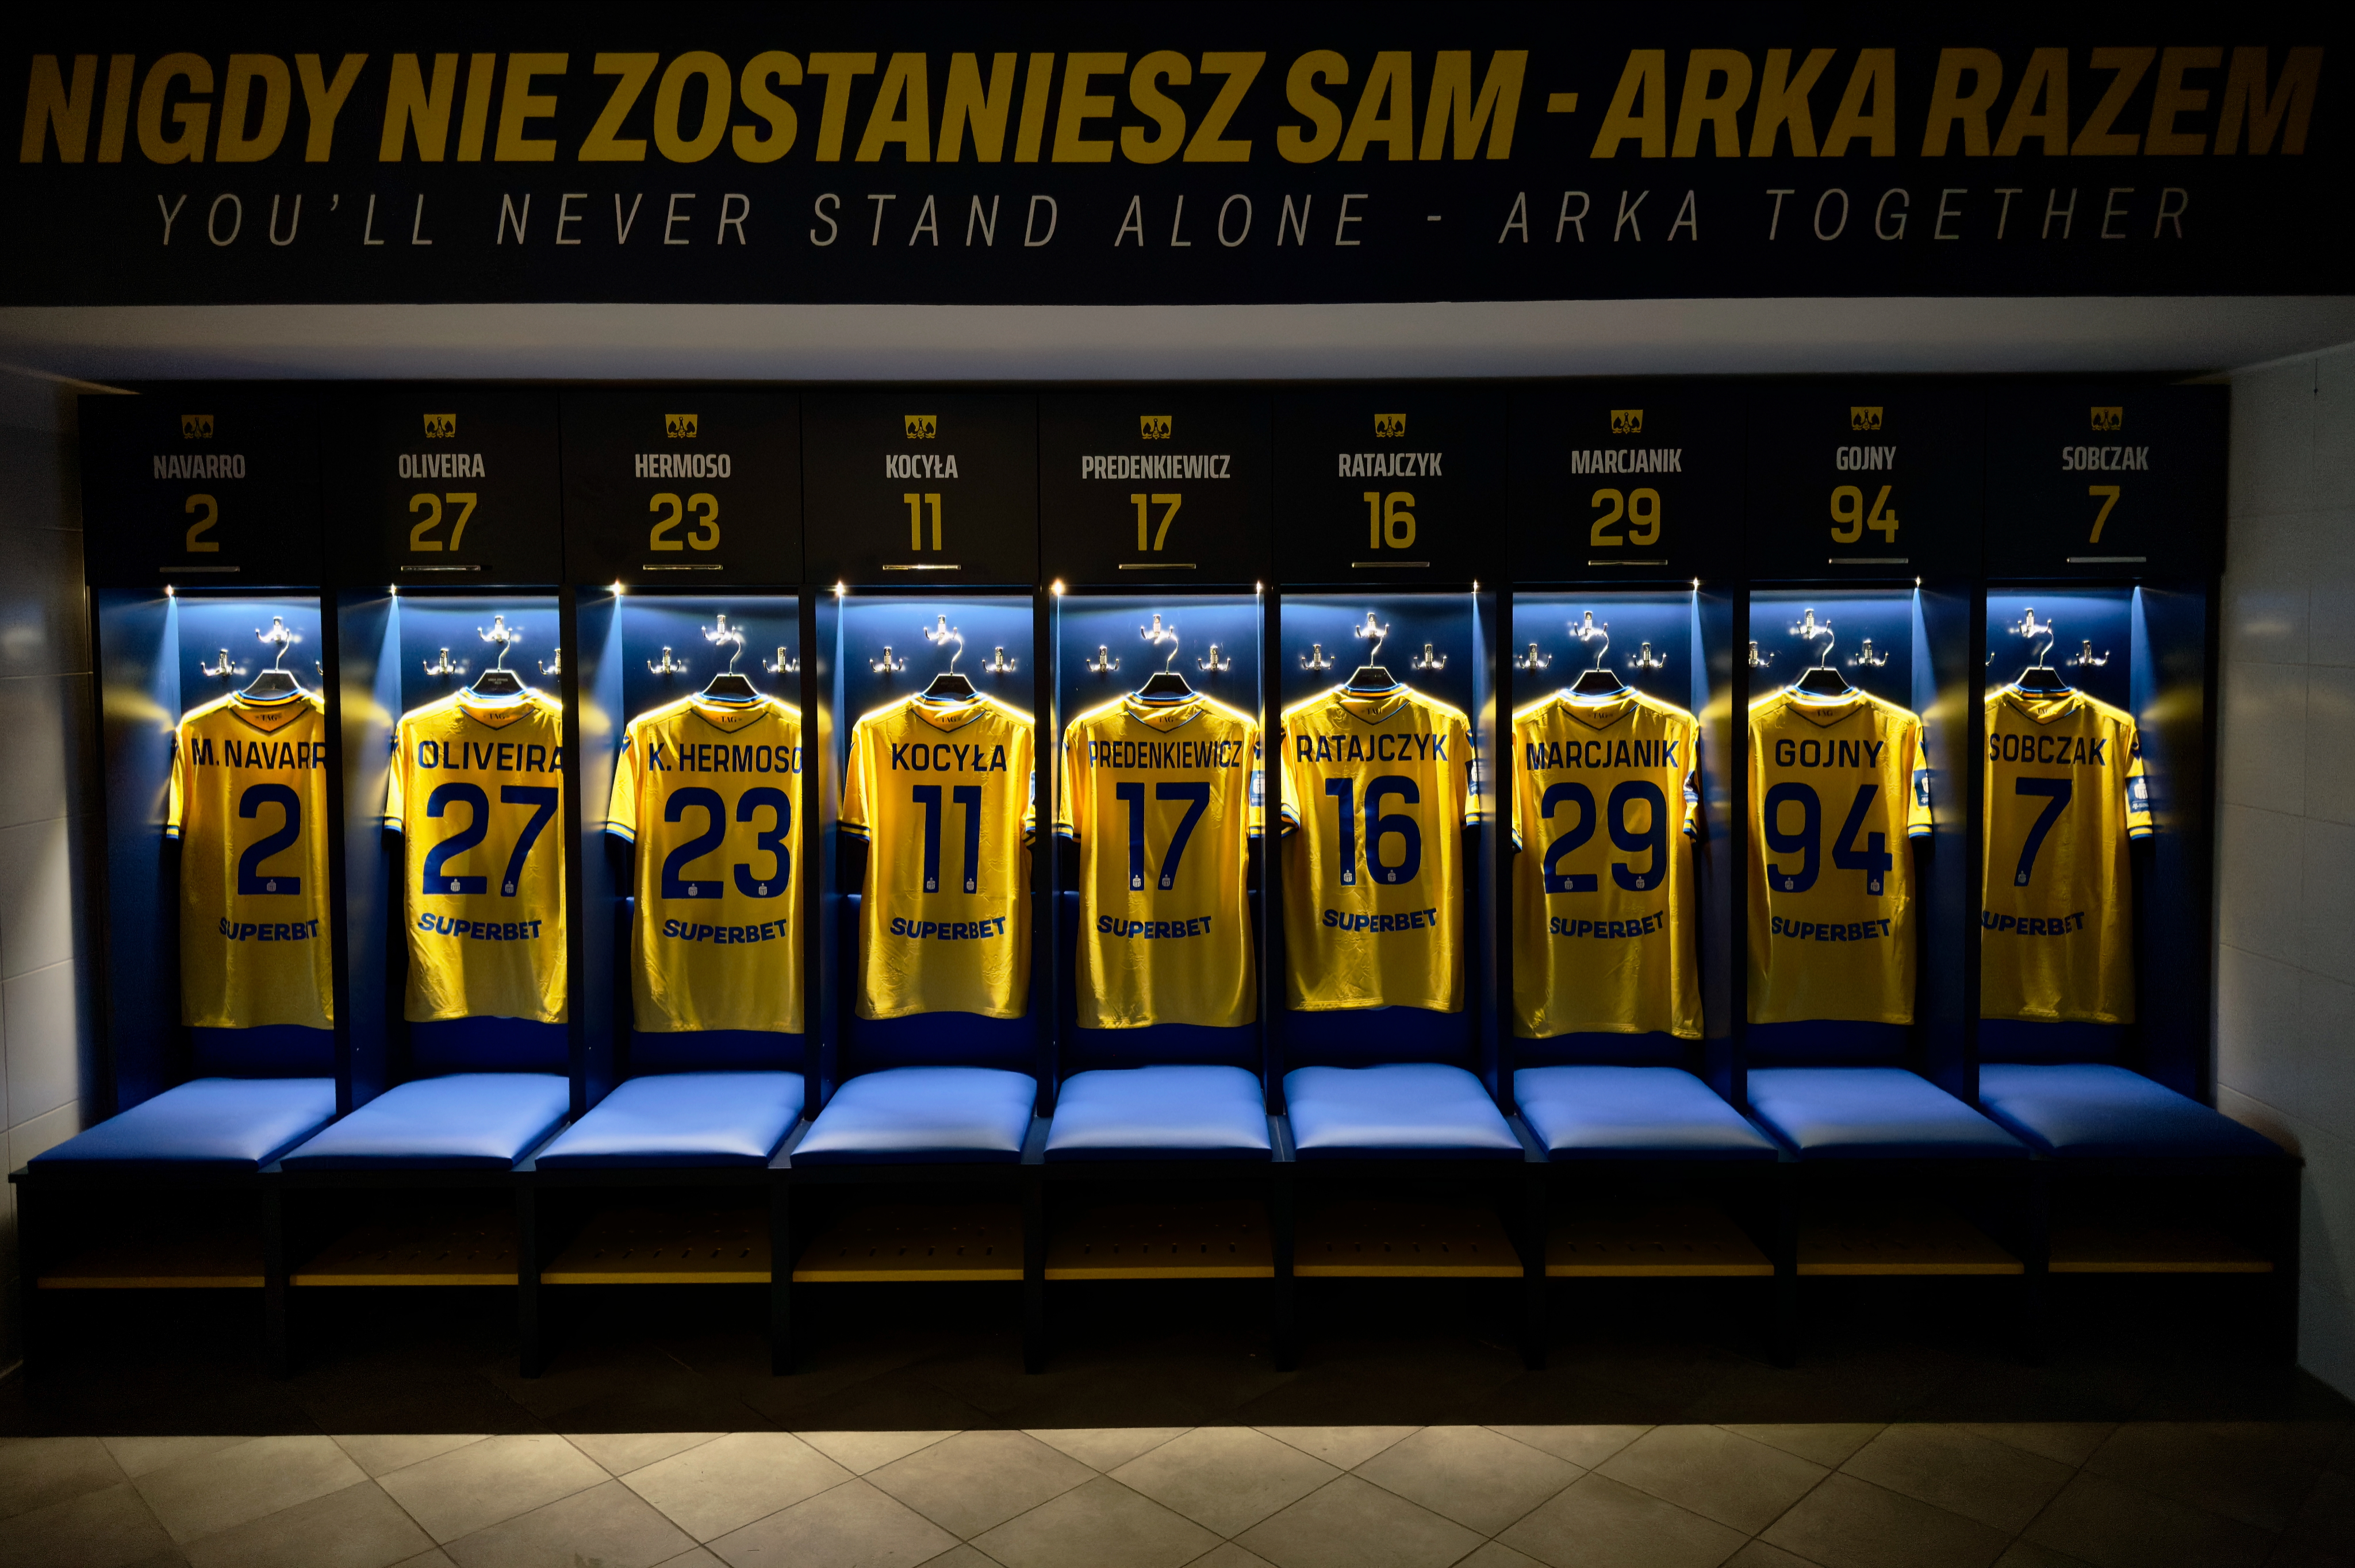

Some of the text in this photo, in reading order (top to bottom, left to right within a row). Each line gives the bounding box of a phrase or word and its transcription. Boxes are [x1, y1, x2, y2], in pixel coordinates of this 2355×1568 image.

[20, 46, 2325, 164] NIGDY NIE ZOSTANIESZ SAM - ARKA RAZEM
[496, 193, 750, 246] NEVER
[810, 193, 1058, 247] STAND
[1114, 194, 1368, 247] ALONE
[1498, 190, 1698, 244] ARKA
[1765, 187, 2189, 241] TOGETHER
[153, 455, 246, 479] NAVARRO
[398, 454, 485, 478] OLIVEIRA
[635, 454, 731, 478] HERMOSO
[885, 454, 959, 479] KOCYŁA
[1081, 455, 1231, 479] PREDENKIEWICZ
[1338, 452, 1443, 478] RATAJCZYK
[1571, 448, 1682, 474] MARCJANIK
[1836, 446, 1896, 471] GOJNY
[2062, 446, 2149, 471] SOBCZAK
[185, 493, 220, 552] 2
[409, 492, 477, 552] 27
[649, 493, 720, 551] 23
[903, 493, 942, 551] 11
[1130, 493, 1182, 551] 17
[1363, 491, 1416, 549] 16
[1590, 487, 1661, 547] 29
[1831, 485, 1899, 544] 94
[2088, 485, 2121, 544] 7
[191, 738, 325, 770] M. NAVARR
[418, 740, 563, 773] OLIVEIRA
[649, 743, 802, 774] K. HERMOSO
[892, 743, 1007, 772] KOCYŁA
[1088, 740, 1242, 769] PREDENKIEWICZ
[1297, 733, 1448, 763] RATAJCZYK
[1526, 740, 1679, 771] MARCJANIK
[1775, 739, 1883, 768] GOJNY
[1989, 733, 2107, 766] SOBCZAK
[237, 783, 301, 895] 2
[422, 782, 559, 897] 27
[661, 786, 792, 900] 23
[912, 785, 982, 894] 11
[1116, 782, 1210, 890] 17
[1325, 775, 1421, 886] 16
[1541, 780, 1667, 894] 29
[1764, 782, 1893, 896] 94
[2014, 777, 2072, 887] 7
[417, 912, 542, 940] SUPERBET
[662, 918, 788, 944] SUPERBET
[889, 916, 1006, 940] SUPERBET
[1096, 915, 1212, 939] SUPERBET
[1322, 908, 1437, 933] SUPERBET
[1549, 910, 1664, 939] SUPERBET
[1771, 916, 1891, 941] SUPERBET
[1982, 910, 2085, 936] UPERBET
